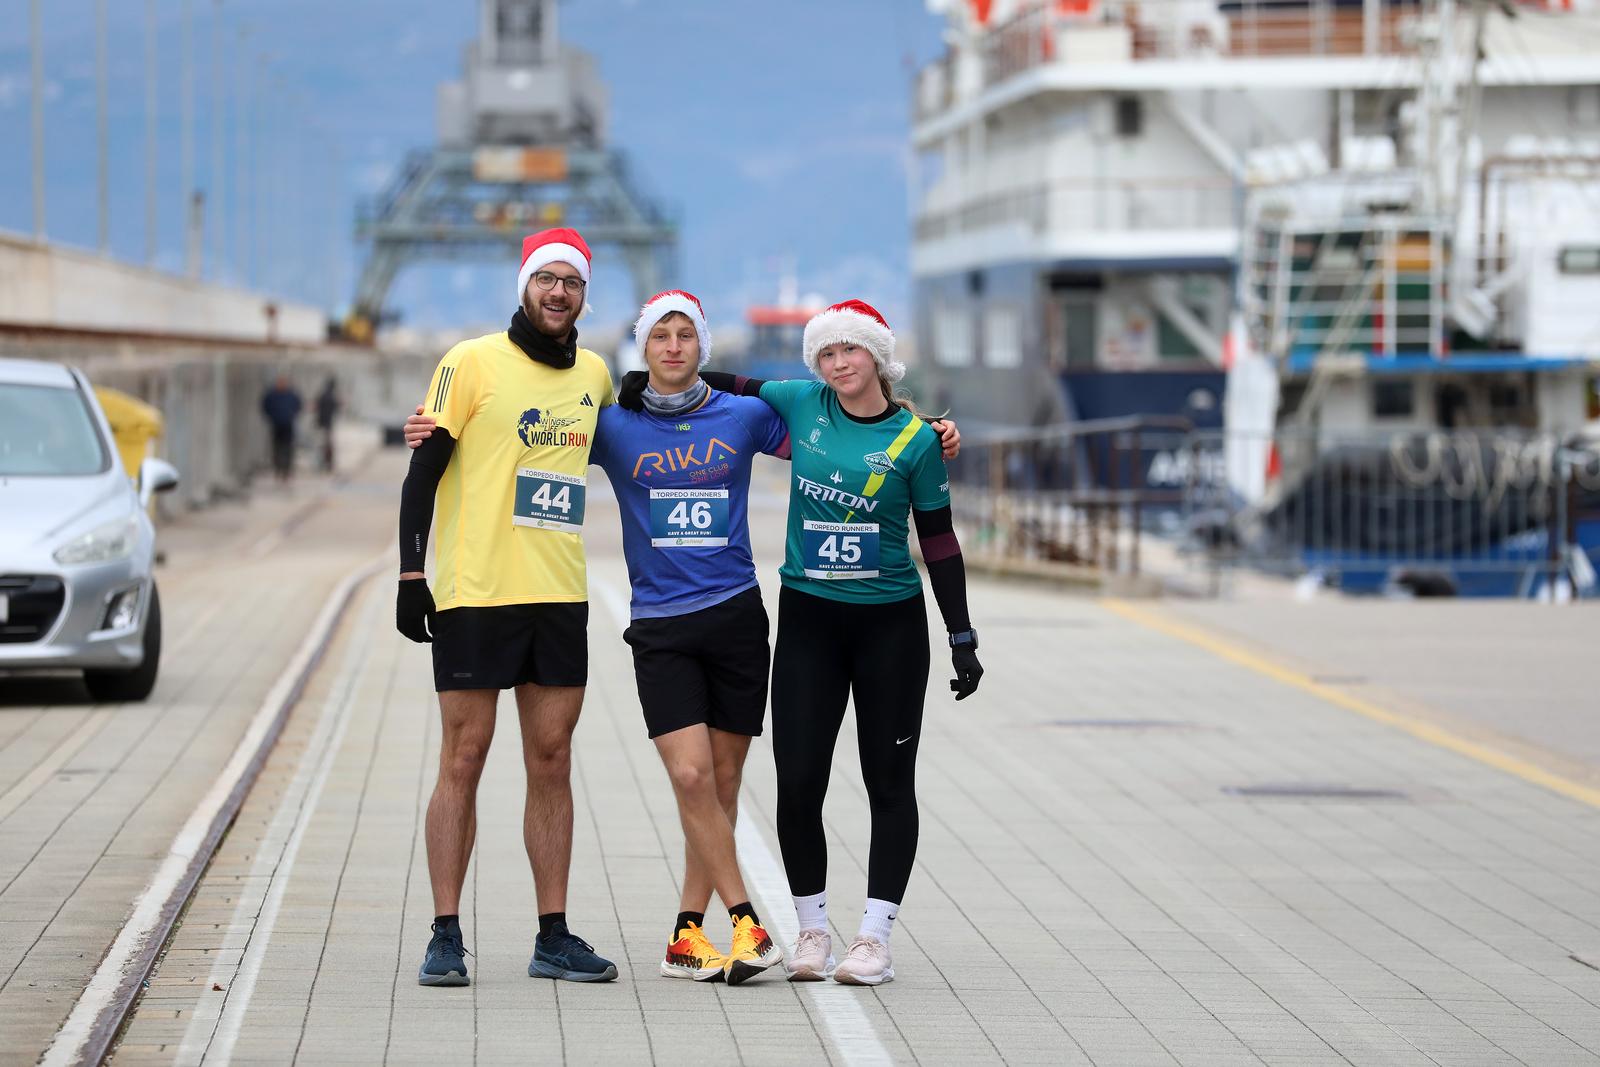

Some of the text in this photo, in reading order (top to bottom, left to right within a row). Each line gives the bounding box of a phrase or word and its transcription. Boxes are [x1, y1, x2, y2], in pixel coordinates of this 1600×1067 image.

[531, 431, 588, 447] WORLD RUN
[633, 438, 737, 479] RIKA
[689, 462, 729, 478] ONE CLUB
[525, 470, 581, 484] TORPEDO RUNNERS
[531, 482, 572, 514] 44
[796, 474, 880, 513] TRITON
[667, 501, 712, 529] 46
[811, 524, 840, 532] TORPEDO
[818, 534, 862, 563] 45
